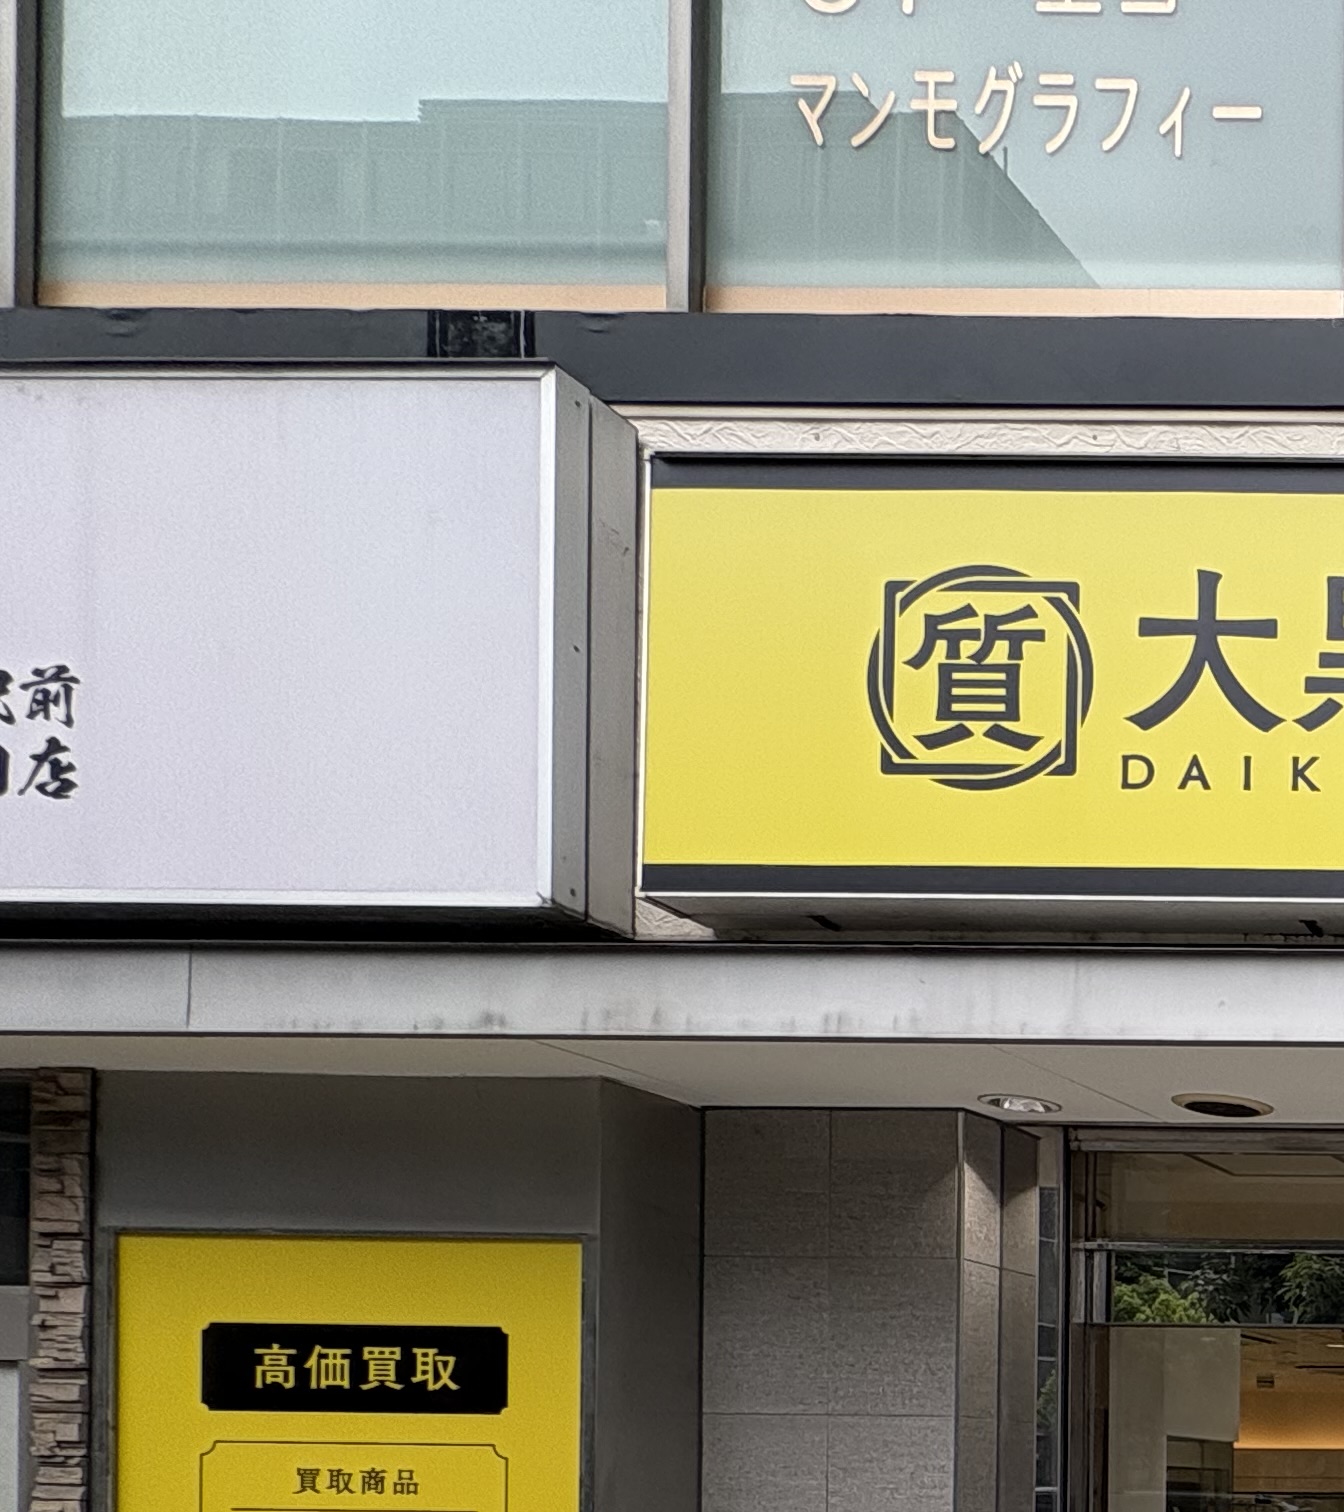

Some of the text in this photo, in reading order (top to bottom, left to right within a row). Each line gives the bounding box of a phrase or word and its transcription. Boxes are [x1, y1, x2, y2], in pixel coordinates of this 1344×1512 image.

[790, 61, 1263, 157] マンモグラフィー
[903, 603, 1046, 750] 質
[0, 736, 79, 799] 店
[254, 1344, 461, 1391] 高価買取
[292, 1467, 420, 1496] 買取商品
